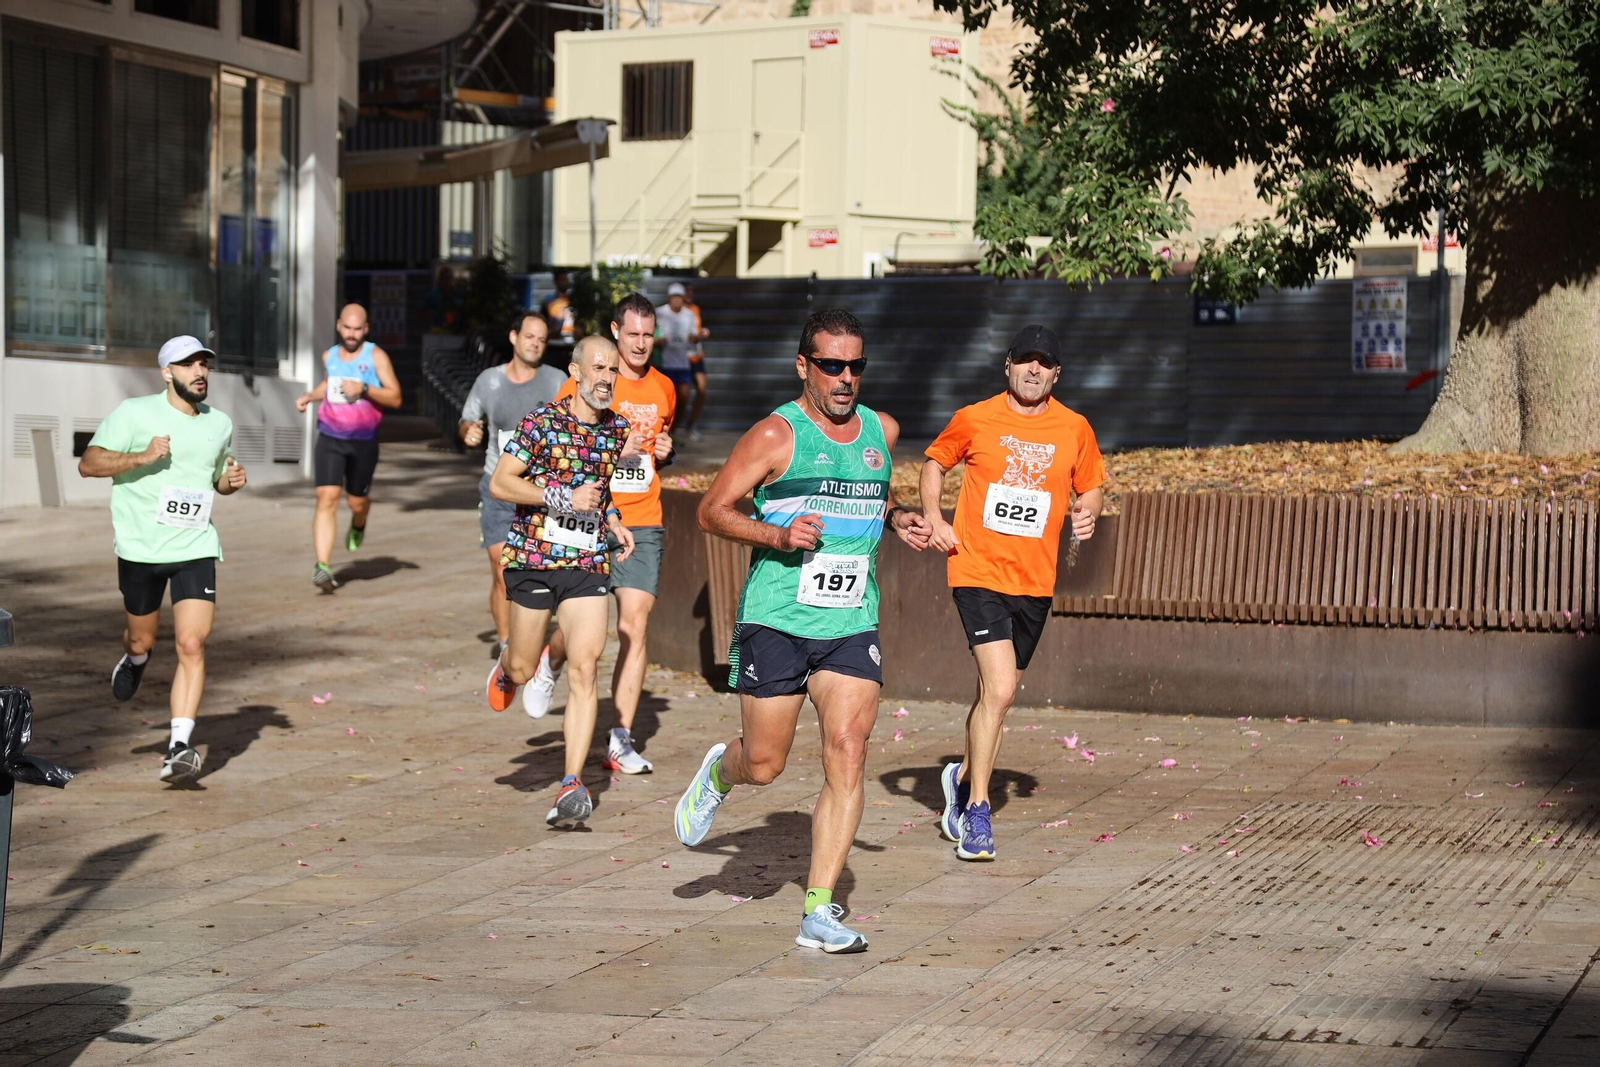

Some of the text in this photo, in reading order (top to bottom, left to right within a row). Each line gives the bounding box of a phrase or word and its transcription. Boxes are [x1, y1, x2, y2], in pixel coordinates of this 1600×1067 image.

[615, 468, 645, 480] 598
[819, 480, 881, 497] ATLETISMO
[166, 501, 202, 516] 897
[995, 502, 1038, 522] 622
[555, 515, 595, 535] 1012
[813, 573, 857, 592] 197
